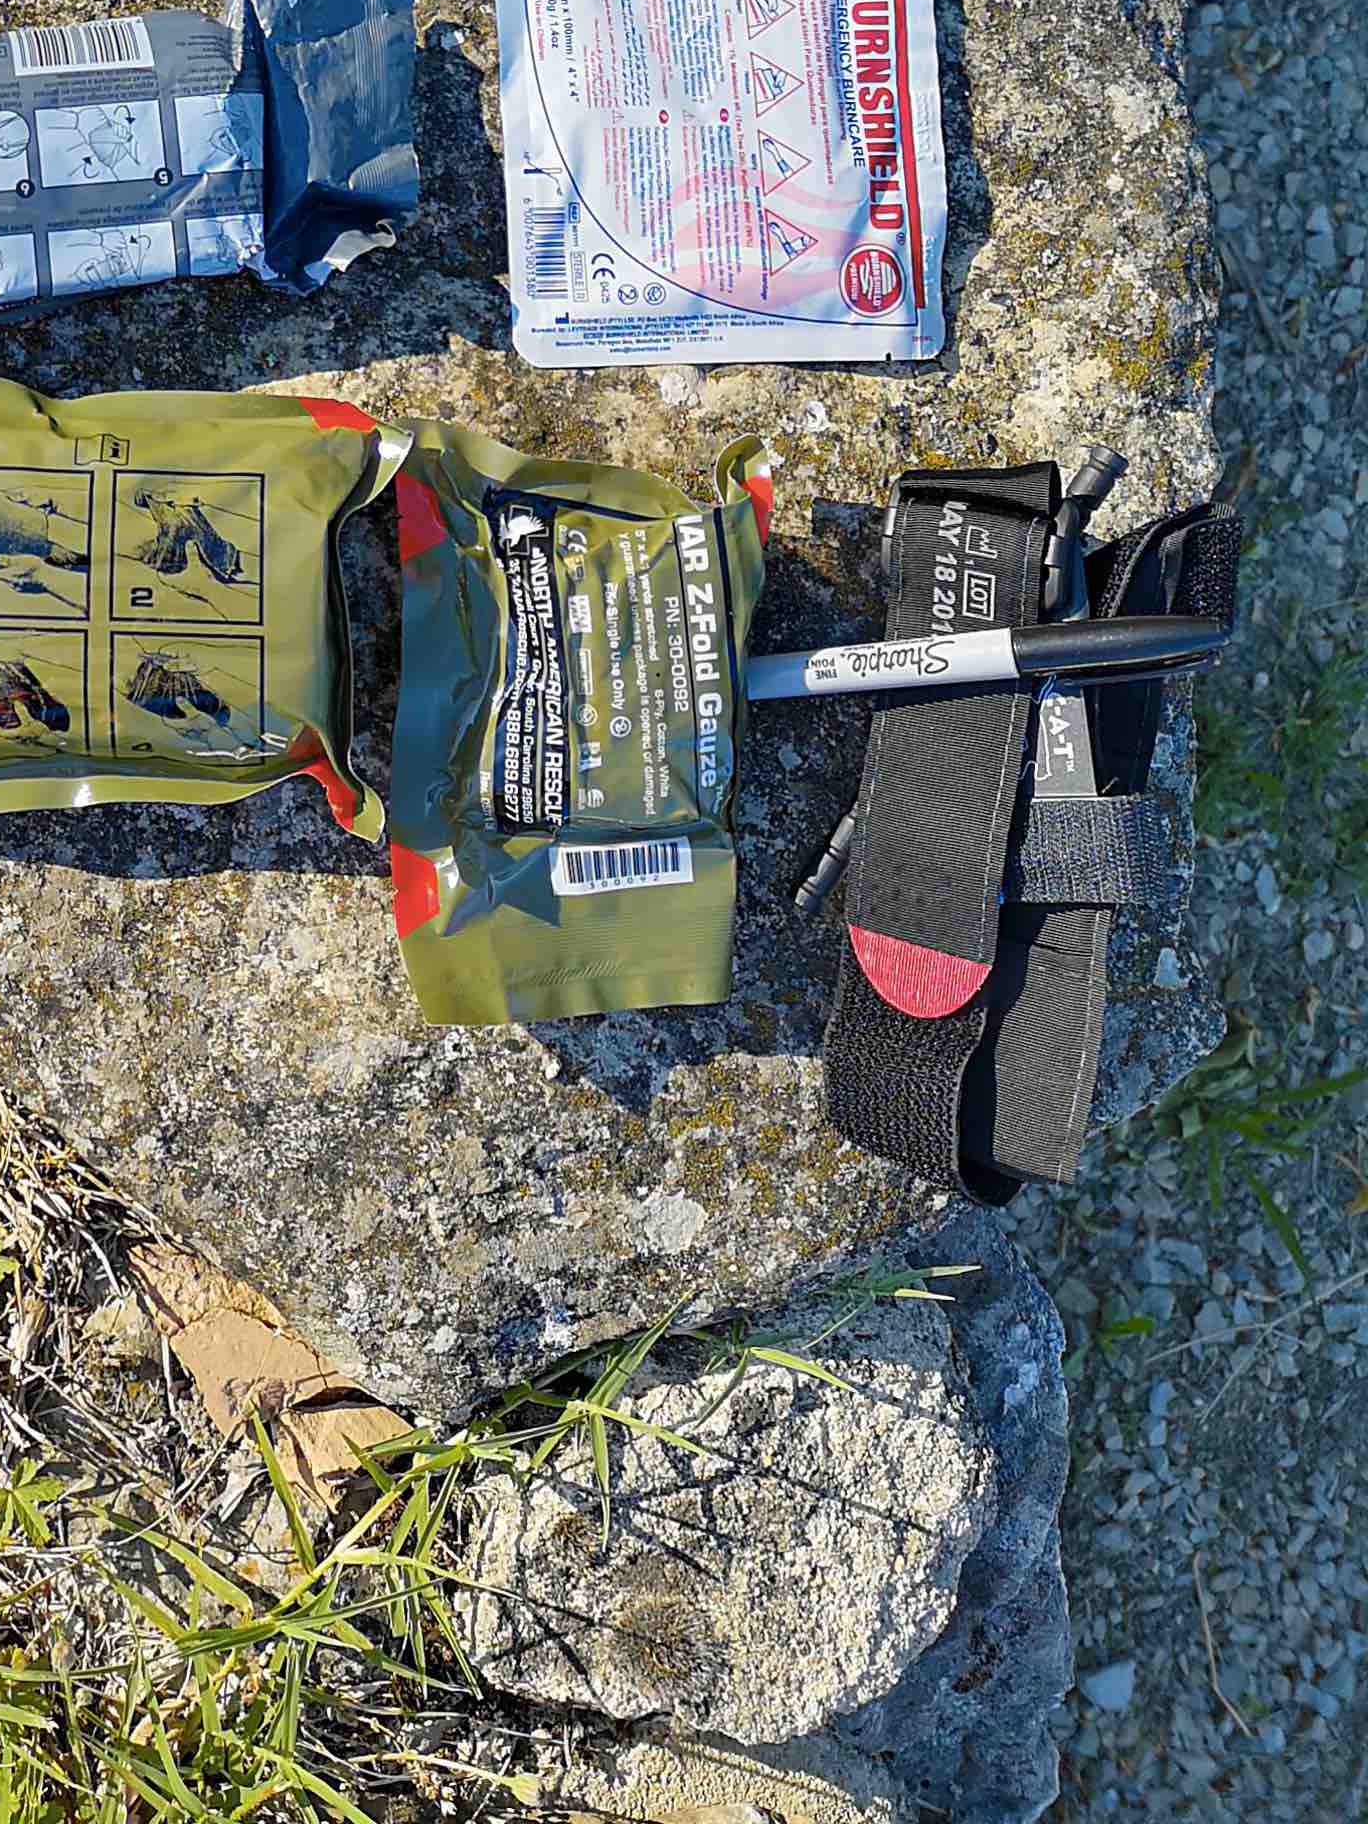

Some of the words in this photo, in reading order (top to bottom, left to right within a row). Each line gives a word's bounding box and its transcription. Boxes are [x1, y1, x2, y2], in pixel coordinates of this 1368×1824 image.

[563, 17, 575, 55] 100mm
[842, 78, 866, 168] BURNCARE
[21, 182, 30, 196] 6
[935, 553, 958, 582] 18
[130, 587, 154, 608] 2
[664, 596, 680, 627] PN:
[931, 586, 957, 636] 201
[969, 577, 989, 615] LOT
[606, 606, 622, 649] Single
[686, 582, 721, 681] Z-Fold
[531, 557, 556, 628] NORTH
[545, 635, 564, 745] AMERICAN
[610, 651, 623, 677] Use
[632, 644, 649, 693] package
[804, 658, 835, 670] POINT
[847, 640, 956, 678] Sharpie
[667, 635, 688, 712] 30-0092
[815, 668, 838, 680] FINE
[610, 679, 626, 710] Only
[640, 695, 651, 705] is
[524, 697, 536, 733] South
[638, 707, 652, 749] opened
[642, 751, 654, 764] or
[698, 692, 723, 788] Gauze
[504, 708, 522, 823] 888.689.6277
[521, 735, 535, 785] Carolina
[659, 765, 671, 798] White
[521, 786, 534, 824] 29650
